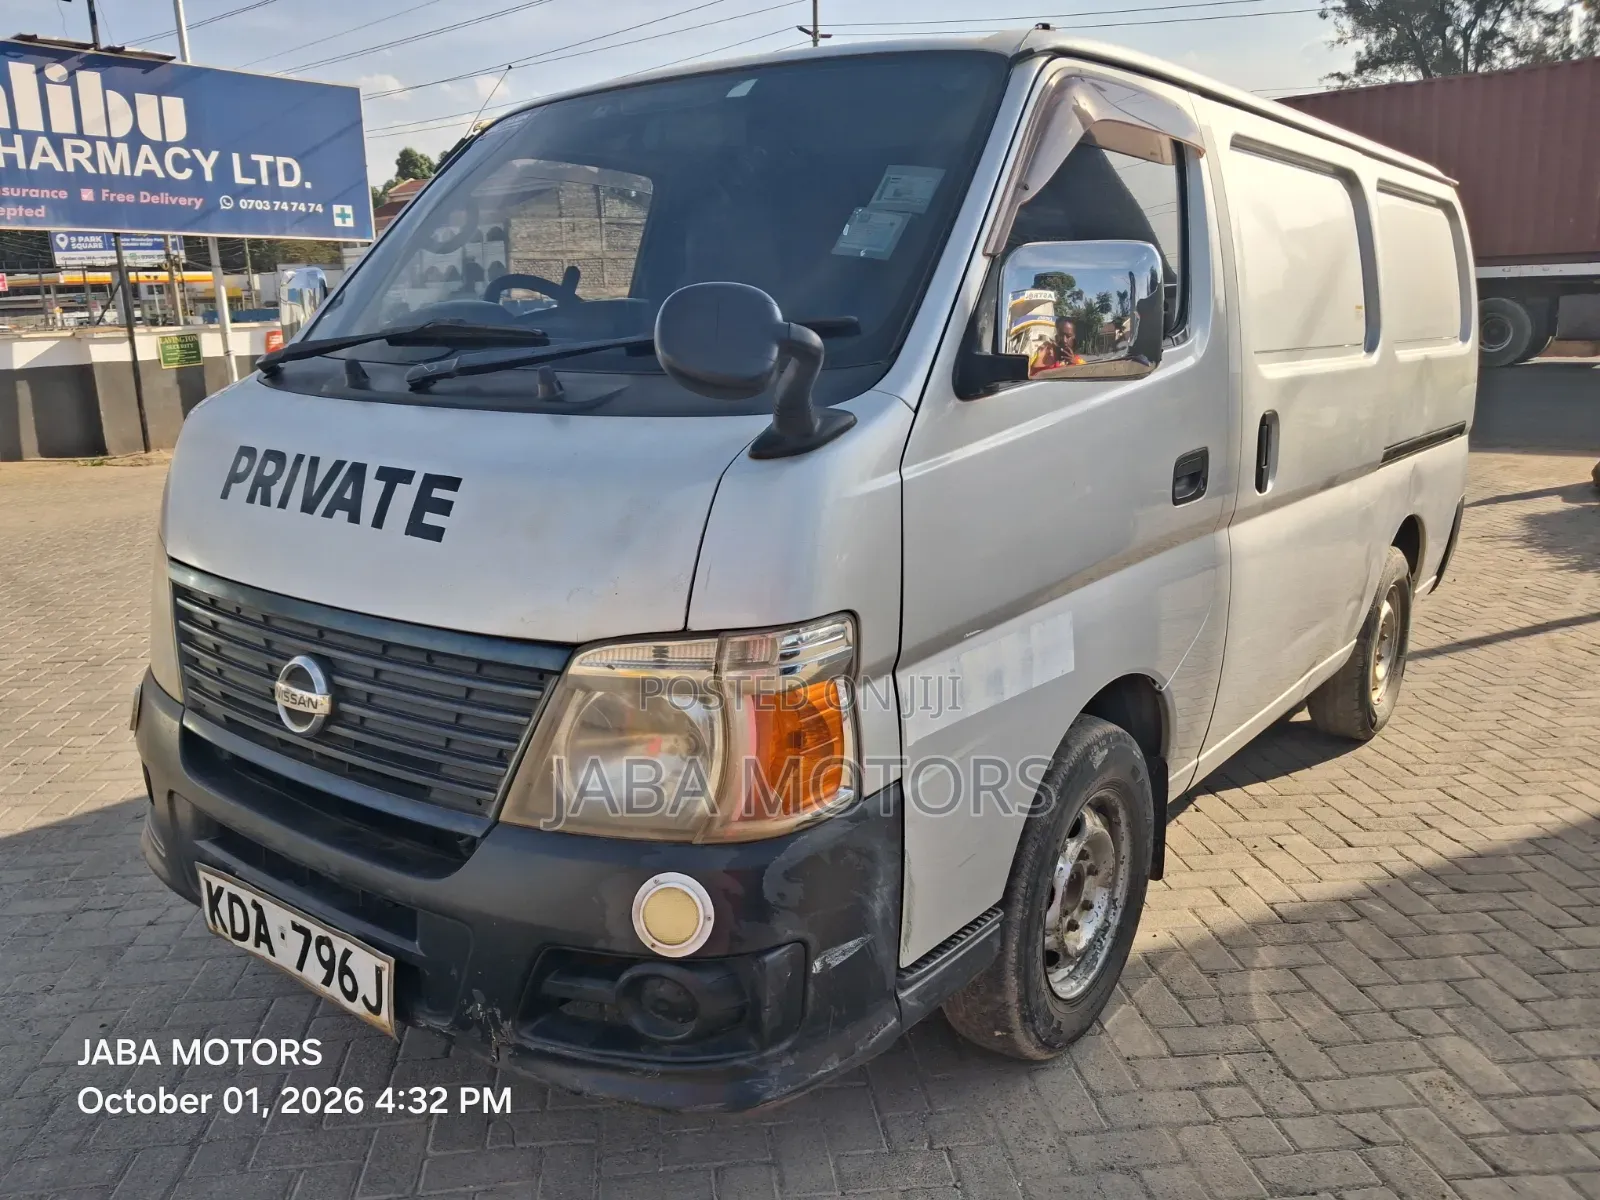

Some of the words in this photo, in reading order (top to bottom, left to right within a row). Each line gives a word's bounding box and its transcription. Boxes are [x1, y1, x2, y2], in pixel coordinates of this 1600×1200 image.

[231, 152, 312, 189] LTD.
[0, 186, 68, 199] surance
[102, 188, 135, 203] Free
[140, 191, 204, 210] Delivery
[239, 198, 271, 211] 0703
[71, 242, 104, 250] SQUARE
[78, 235, 103, 243] PARK
[159, 335, 198, 344] LAVINGTON
[219, 445, 463, 543] PRIVATE
[275, 682, 318, 710] NISSAN
[203, 877, 276, 958] KDA
[290, 919, 383, 1017] 796J
